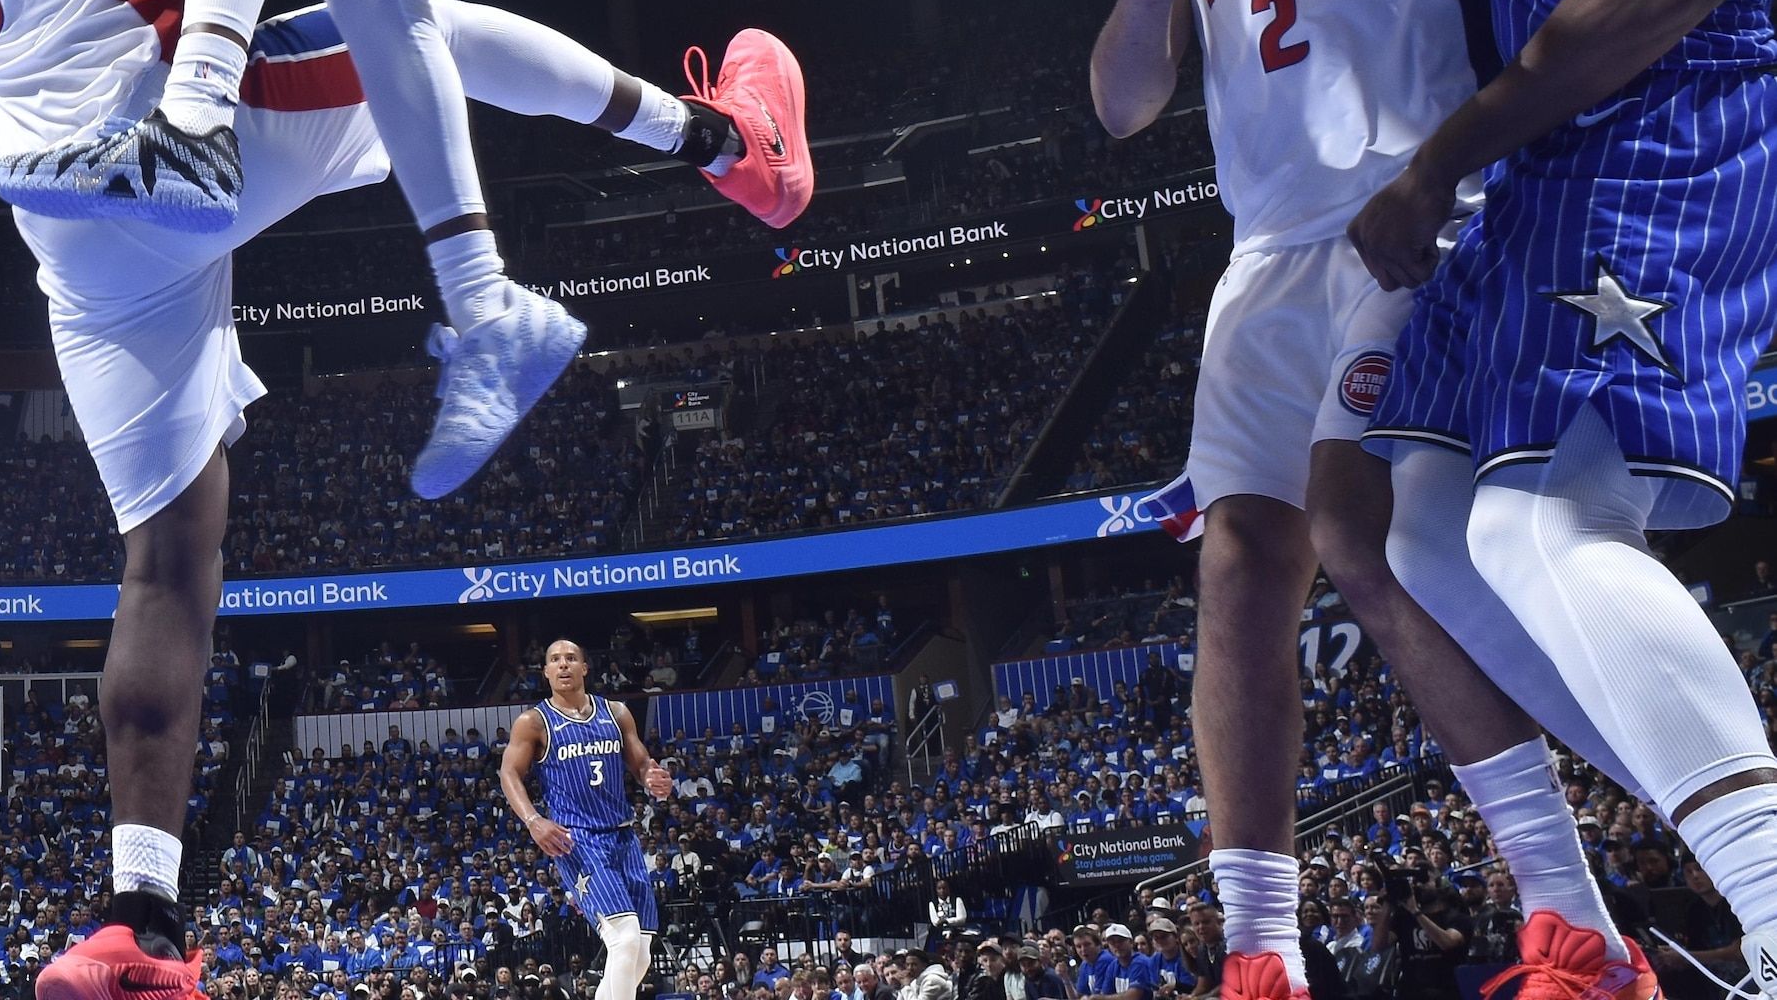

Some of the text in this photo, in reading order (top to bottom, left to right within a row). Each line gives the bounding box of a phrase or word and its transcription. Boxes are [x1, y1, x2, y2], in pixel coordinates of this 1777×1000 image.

[1101, 181, 1219, 218] City Natio
[799, 222, 1008, 269] City National Bank
[525, 265, 710, 300] ity National Bank
[230, 295, 424, 326] City National Bank
[1350, 383, 1380, 396] PISTO
[1352, 371, 1384, 386] DETRO
[676, 413, 710, 425] 111A
[493, 554, 740, 598] City National Bank
[323, 582, 387, 603] Bank
[1300, 622, 1361, 678] 12
[590, 760, 603, 786] 3
[1073, 835, 1185, 859] City National Bank
[1075, 852, 1176, 870] Stay ahead of the game.
